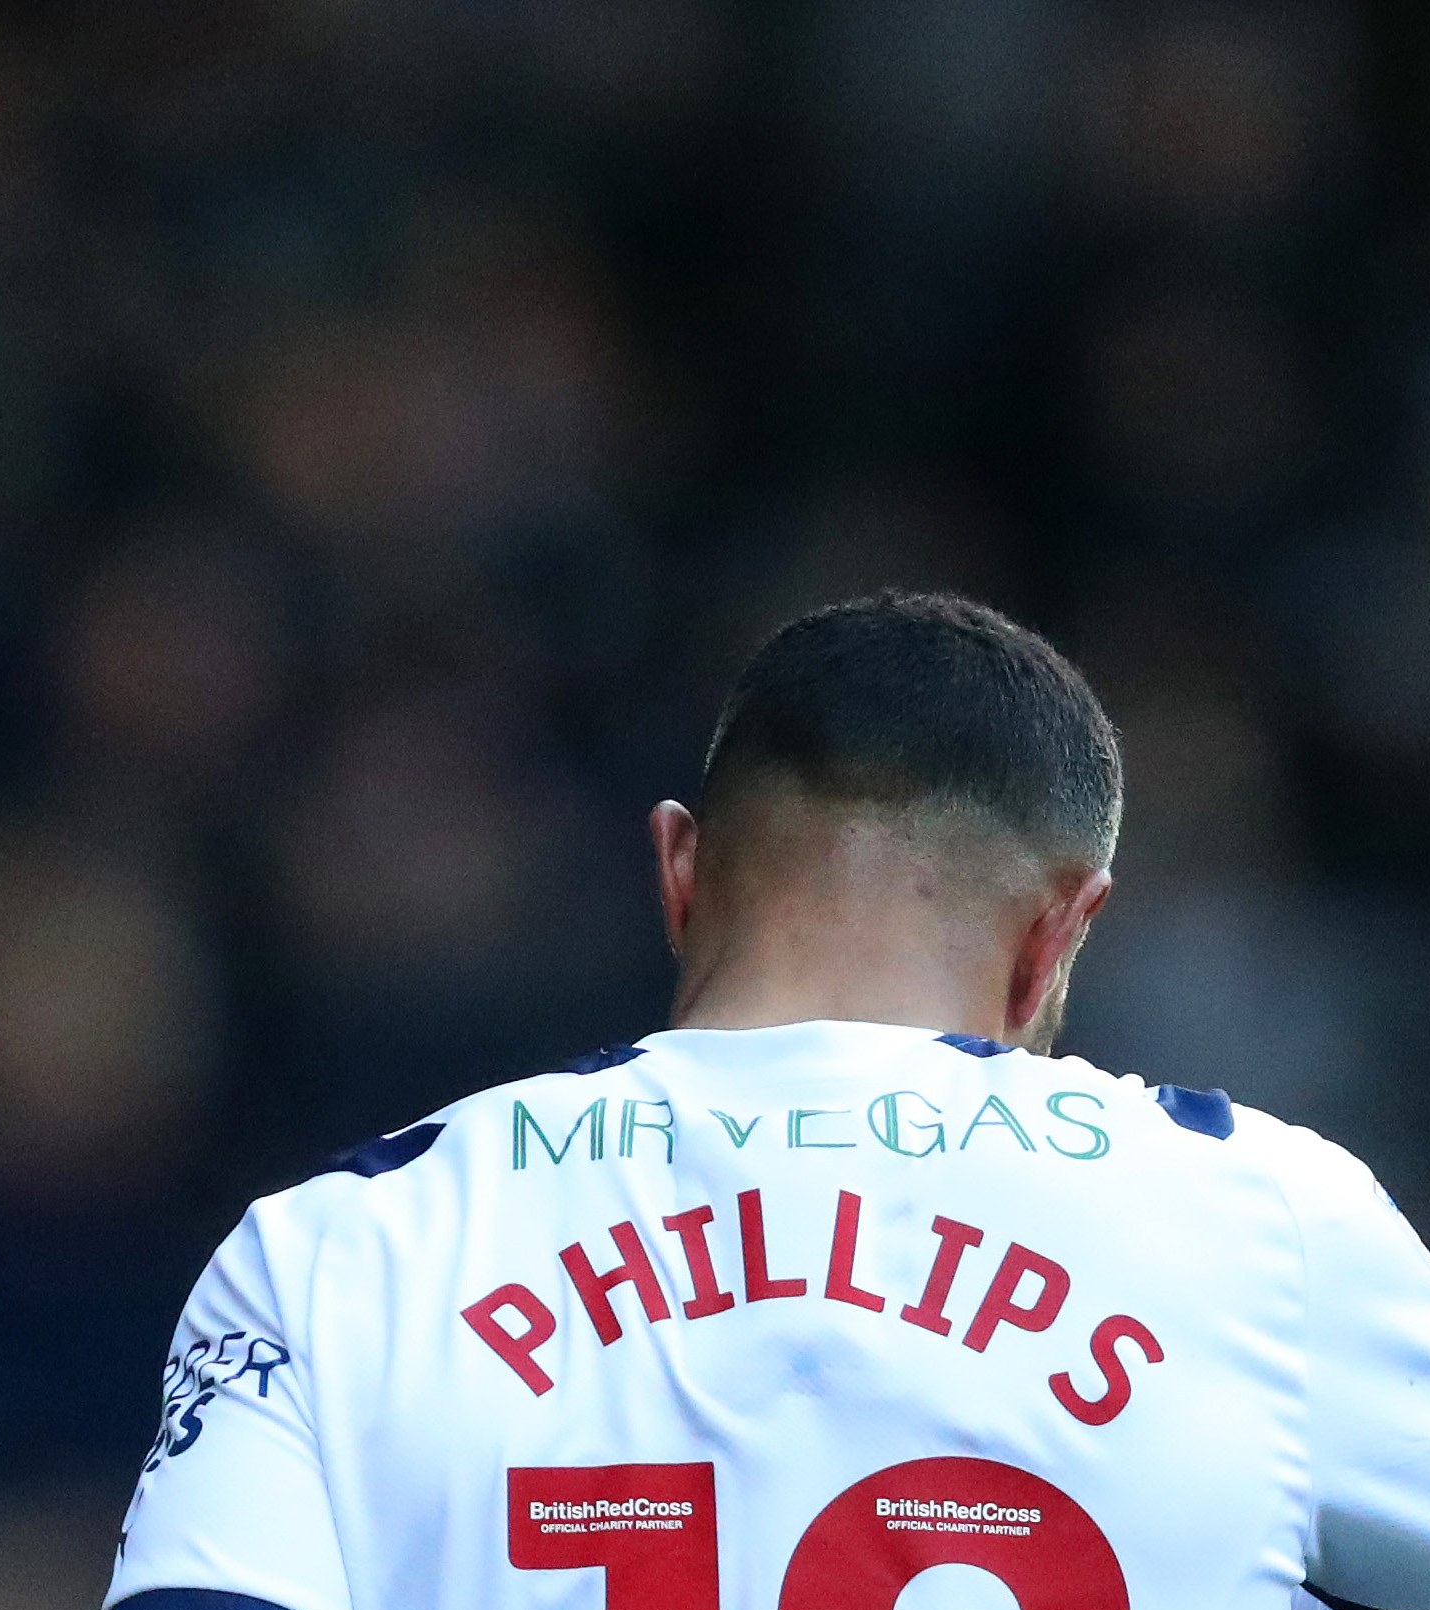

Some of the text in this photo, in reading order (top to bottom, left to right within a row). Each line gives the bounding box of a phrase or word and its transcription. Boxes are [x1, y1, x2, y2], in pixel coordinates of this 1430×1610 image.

[512, 1090, 1112, 1171] MR VEGAS
[460, 1187, 1166, 1427] PHILLIPS
[529, 1497, 694, 1521] BritishRedCross
[875, 1497, 1043, 1523] BritishRedCross
[540, 1519, 683, 1534] OFFICIAL CHARITY PARTNER
[886, 1519, 1032, 1536] OFFICIAL CHARITY PARTNER
